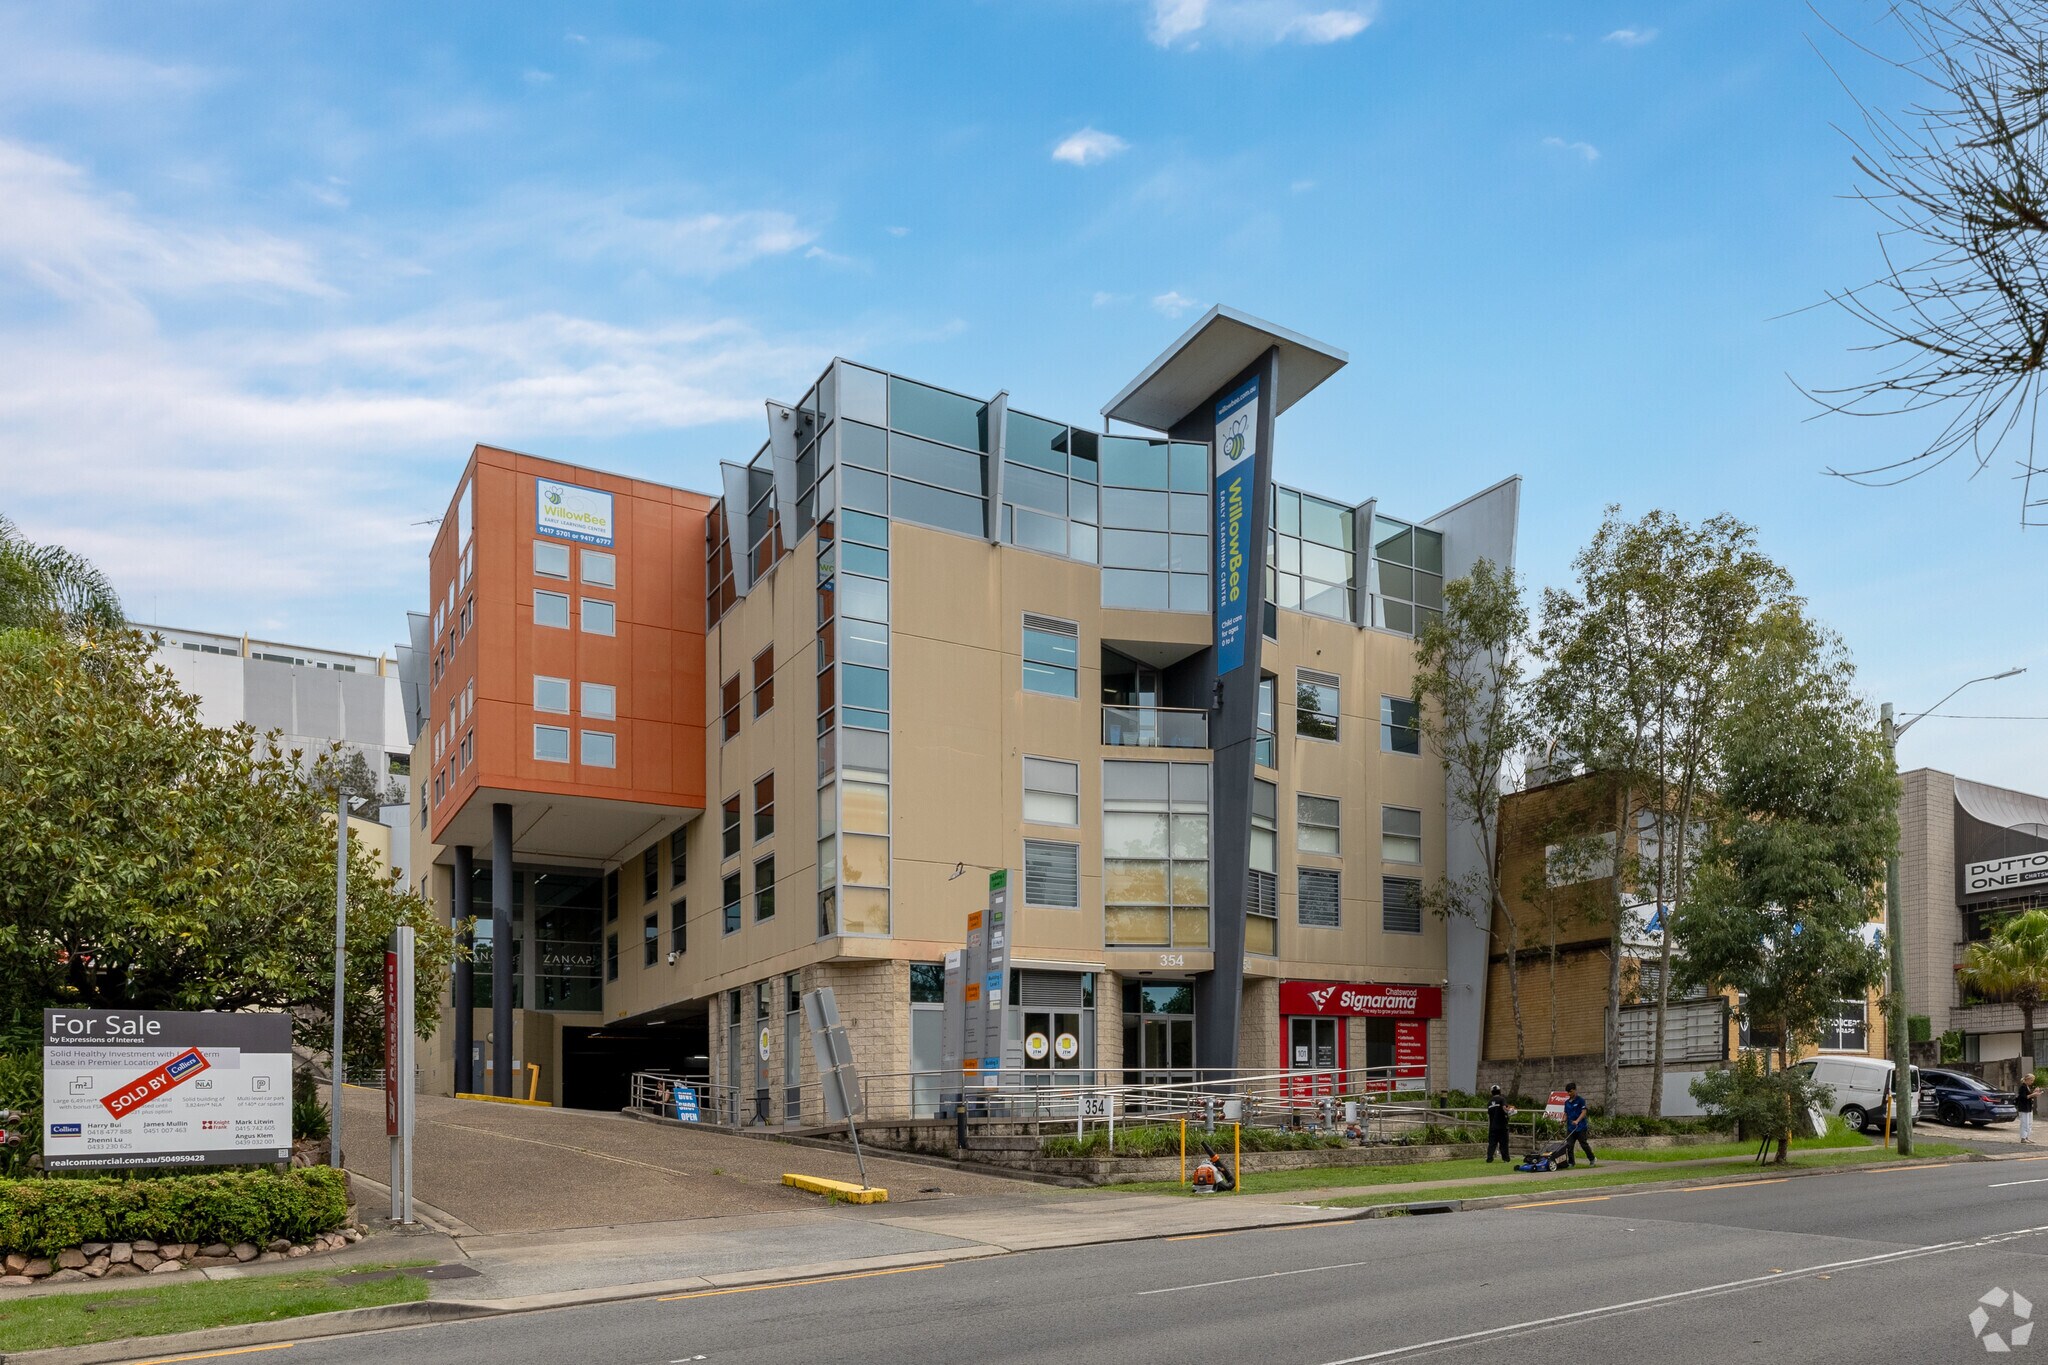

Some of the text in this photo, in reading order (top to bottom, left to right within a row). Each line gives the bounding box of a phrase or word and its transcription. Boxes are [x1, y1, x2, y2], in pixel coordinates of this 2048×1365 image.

[544, 504, 607, 528] WillowBee
[544, 517, 607, 534] EARLY LEARNING CENTRE
[539, 526, 554, 535] 9417
[580, 534, 595, 543] 9417
[1229, 476, 1242, 602] WillowBee
[1221, 614, 1242, 629] Child care
[1229, 625, 1239, 637] ages
[1971, 873, 2018, 889] ONE
[1159, 954, 1185, 967] 354
[1385, 987, 1417, 997] Chatswood
[1340, 990, 1416, 1011] Signarama
[52, 1014, 161, 1035] For Sale
[50, 1036, 60, 1044] by
[61, 1036, 105, 1044] Expressions
[73, 1050, 107, 1059] Healthy
[171, 1057, 197, 1074] Colliers
[111, 1073, 167, 1112] SOLD BY
[1085, 1099, 1105, 1115] 354
[680, 1112, 698, 1121] OPEN
[50, 1155, 205, 1167] realcommercial.com.au/504959428
